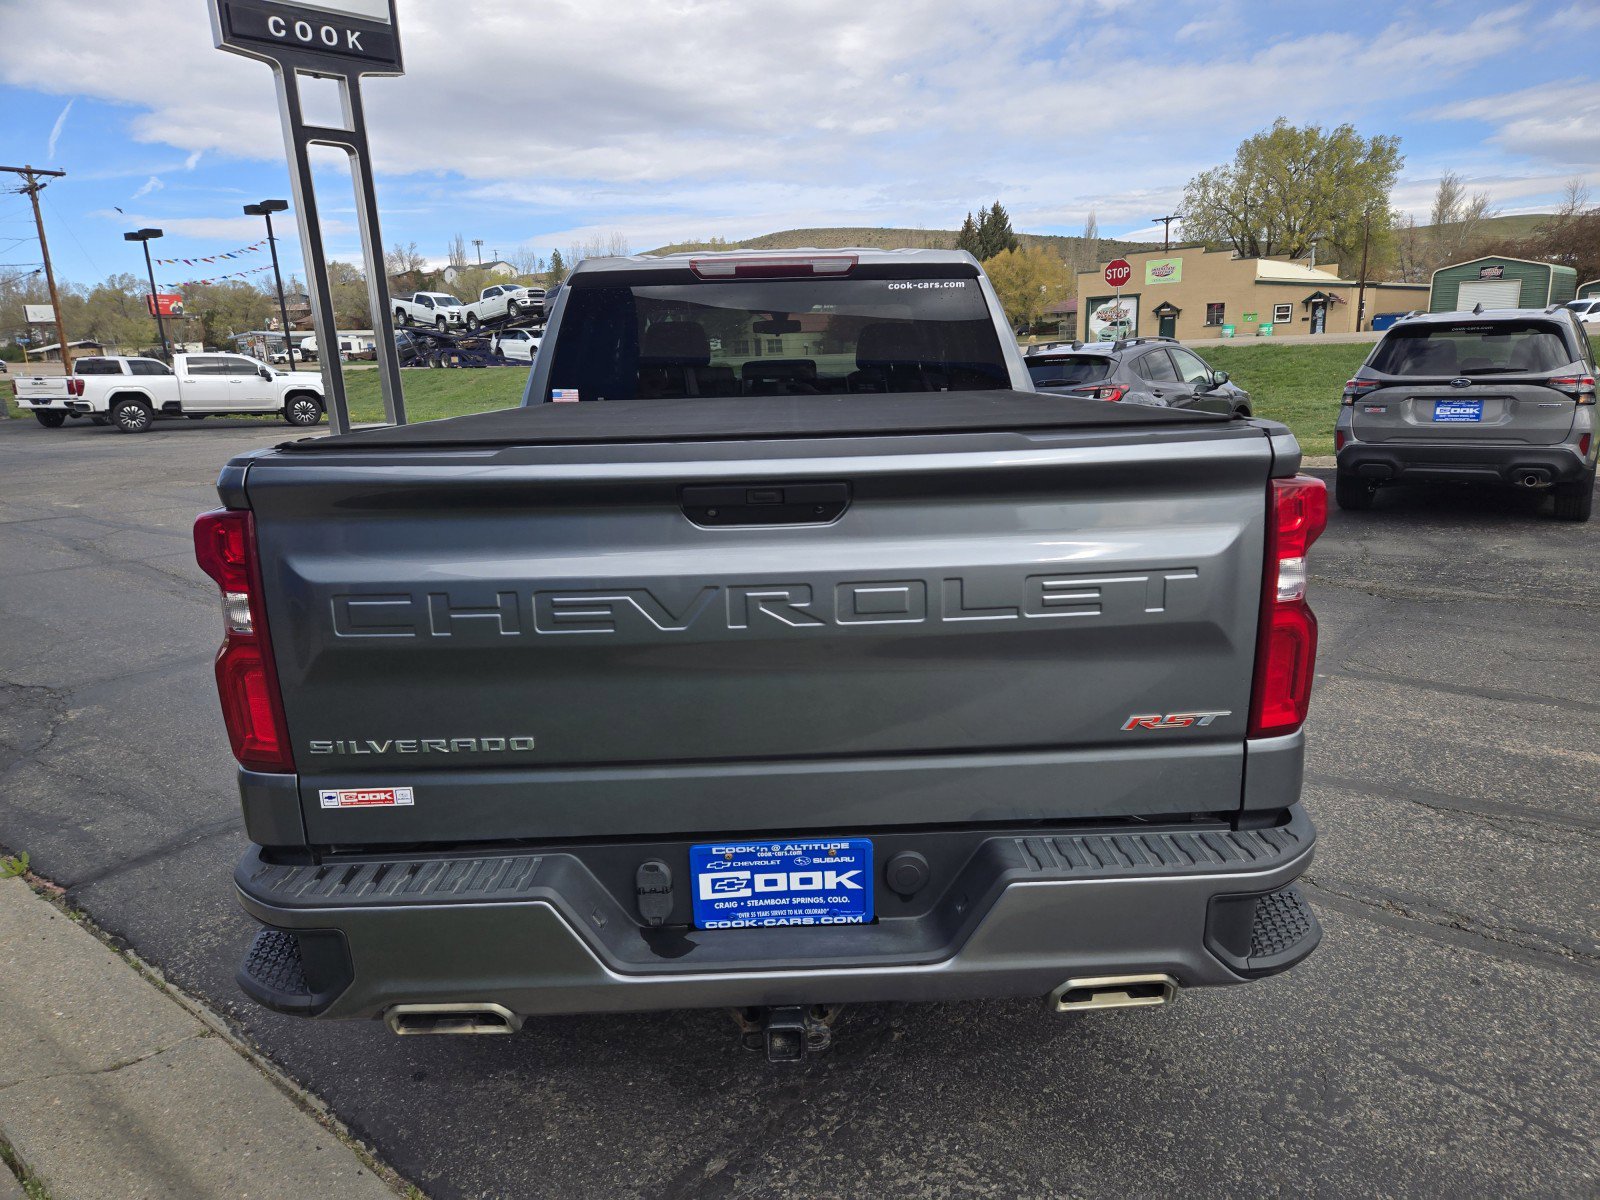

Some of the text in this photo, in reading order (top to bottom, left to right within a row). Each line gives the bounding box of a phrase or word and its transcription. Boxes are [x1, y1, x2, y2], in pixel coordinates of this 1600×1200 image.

[268, 16, 363, 51] COOK
[1106, 267, 1130, 280] STOP
[888, 281, 965, 290] cook-cars.com
[1436, 407, 1480, 415] COOK
[331, 567, 1198, 637] CHEVROLET
[1120, 710, 1232, 730] RST
[309, 736, 535, 754] SILVERADO
[340, 792, 394, 803] COOK
[784, 842, 850, 851] ALTITUDE
[732, 859, 781, 867] CHEVROLET
[812, 856, 855, 864] SUBARU
[699, 870, 863, 900] COOK
[714, 901, 738, 909] CRAIG
[747, 897, 790, 907] STEAMBOAT
[792, 896, 826, 905] SPRINGS,
[705, 916, 863, 929] COOK-CARS.COM
